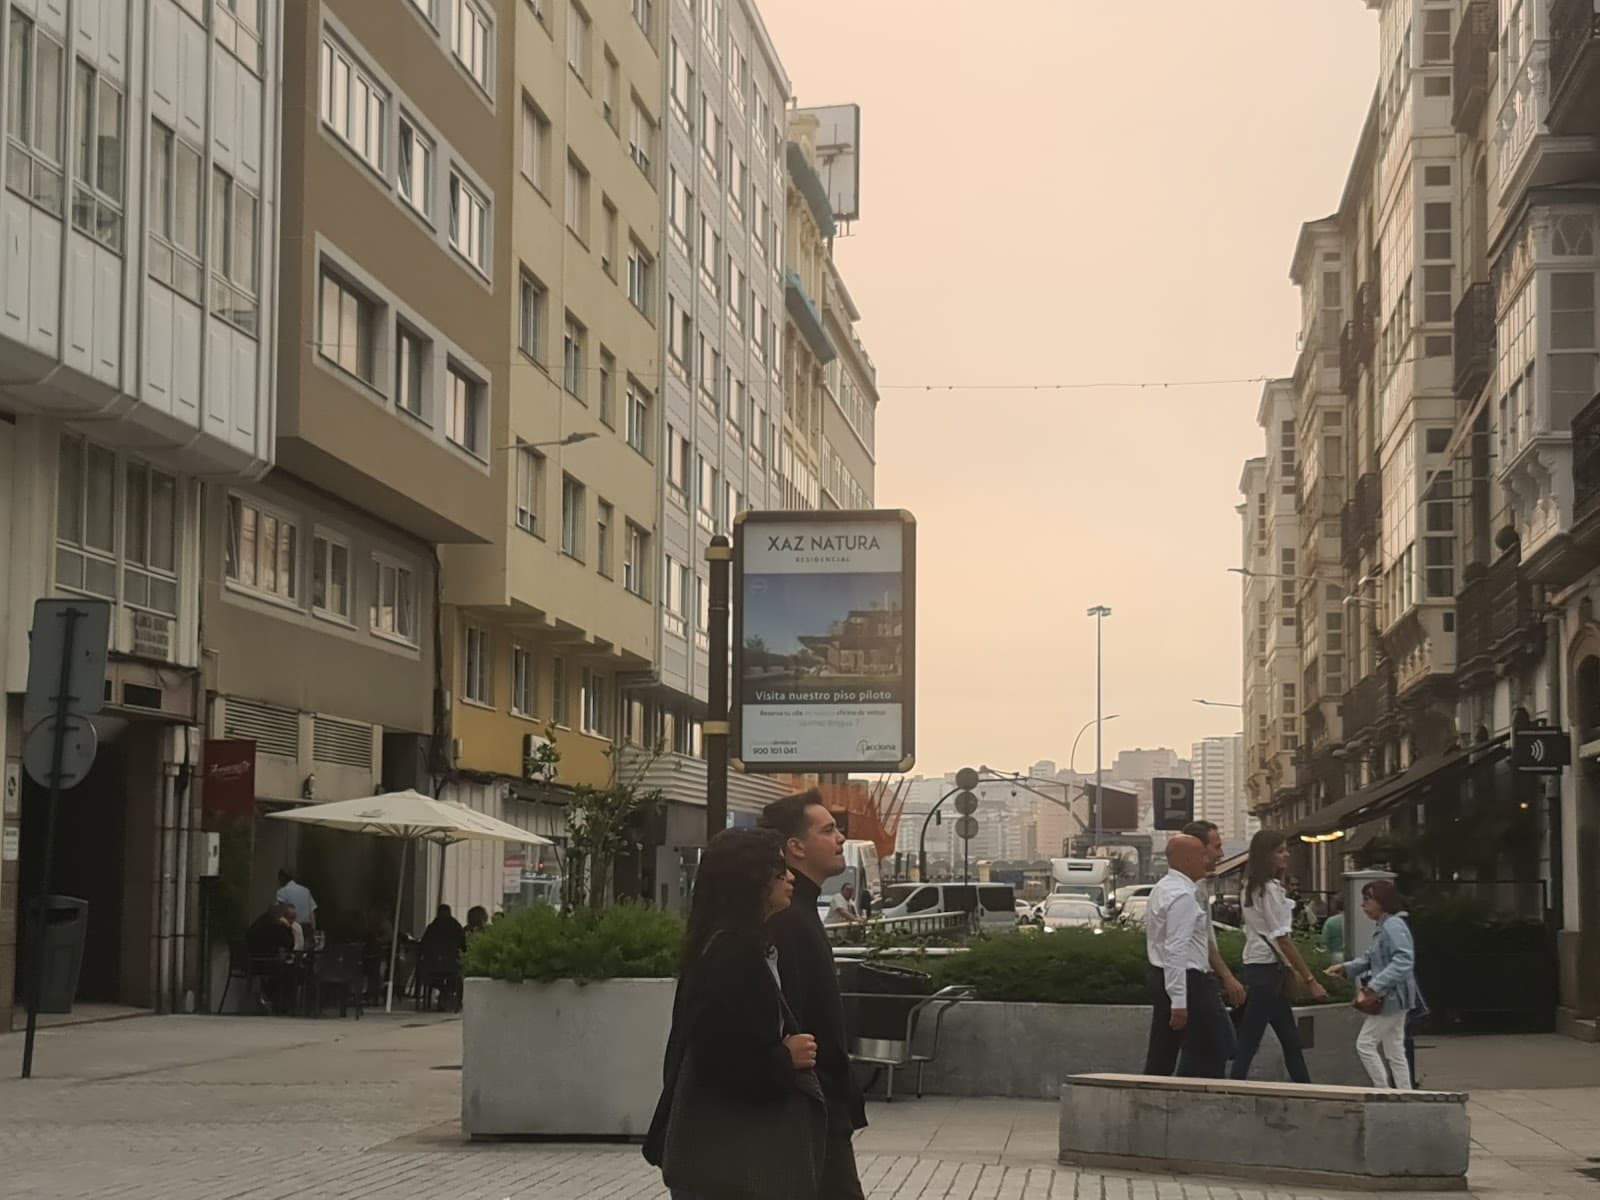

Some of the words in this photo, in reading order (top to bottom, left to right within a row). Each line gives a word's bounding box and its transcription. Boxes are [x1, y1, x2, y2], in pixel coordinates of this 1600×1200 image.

[767, 535, 805, 551] XAZ
[811, 535, 881, 551] NATURA
[755, 690, 786, 701] Visita
[789, 690, 831, 701] nuestro
[833, 690, 856, 702] piso
[858, 689, 892, 702] piloto
[753, 746, 768, 755] 900
[1164, 782, 1187, 809] P
